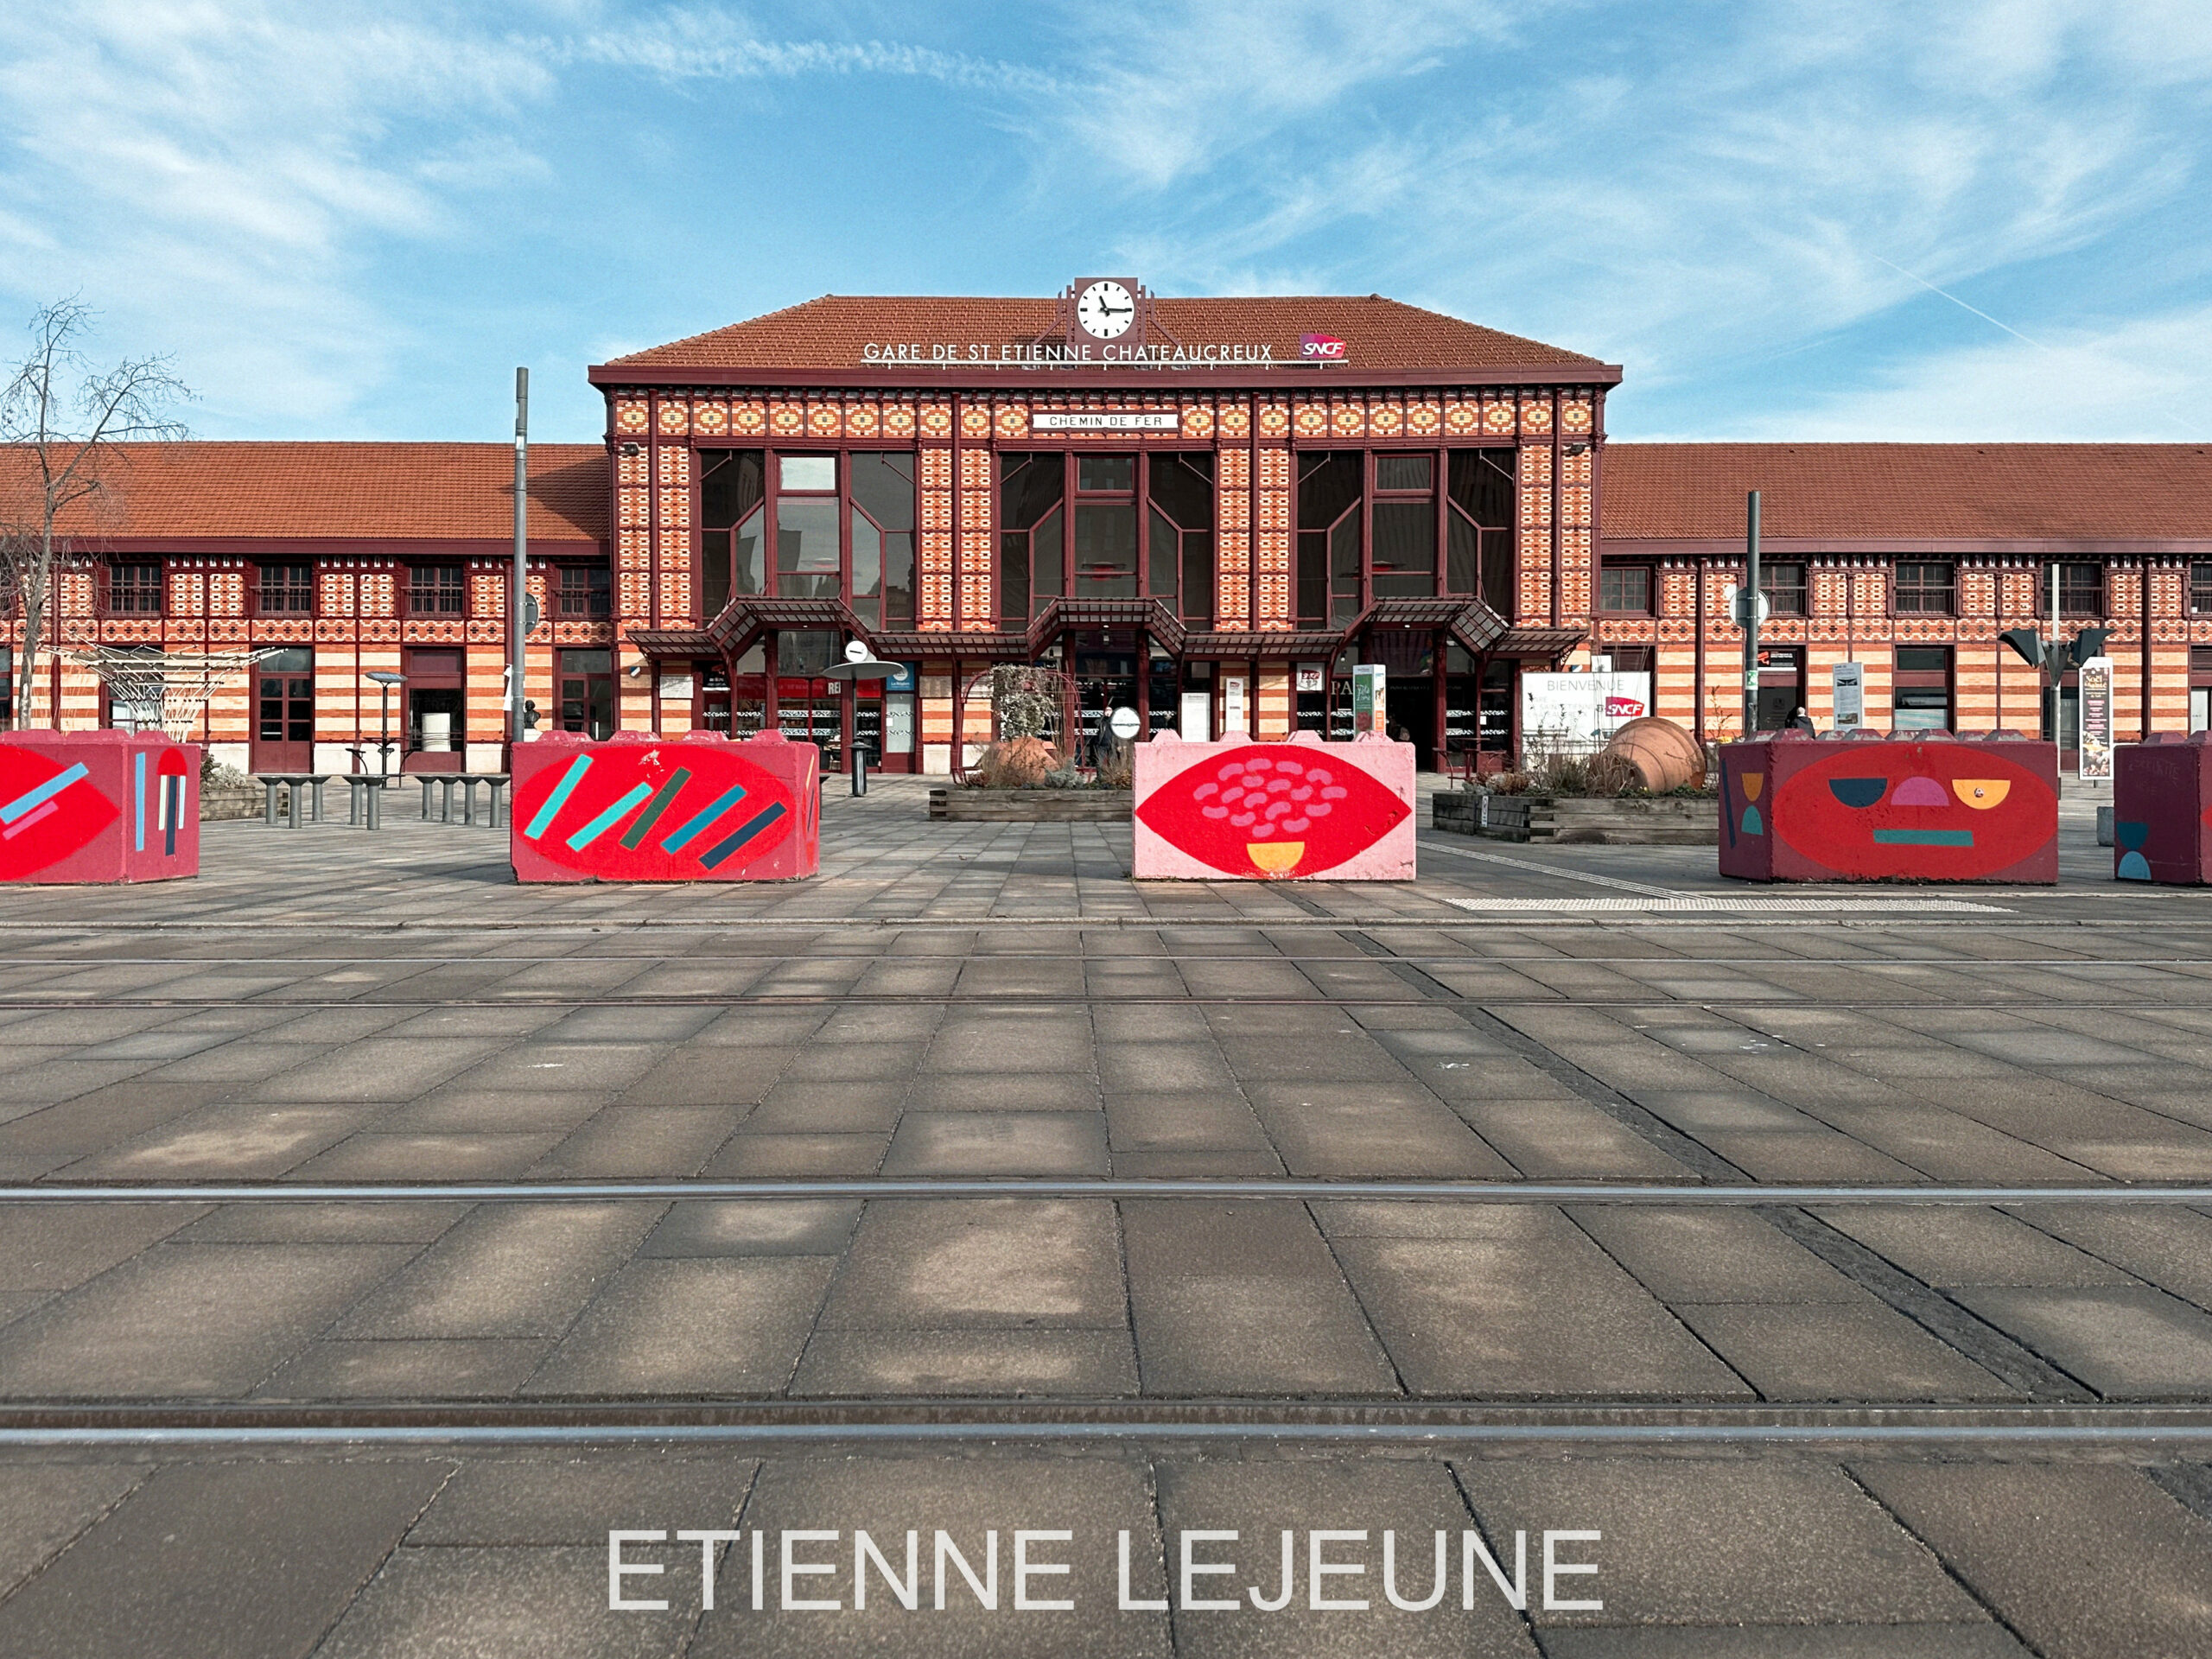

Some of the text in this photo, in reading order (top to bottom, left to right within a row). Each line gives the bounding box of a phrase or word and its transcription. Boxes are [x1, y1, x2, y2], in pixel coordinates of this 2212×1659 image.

[863, 342, 1273, 362] GARE DE ST ETIENNE CHATEAUCREUX
[1301, 341, 1344, 357] SNCF
[1049, 416, 1163, 427] CHEMIN DE FER
[1547, 679, 1625, 692] BIENVENUE
[1605, 703, 1644, 715] SNCF
